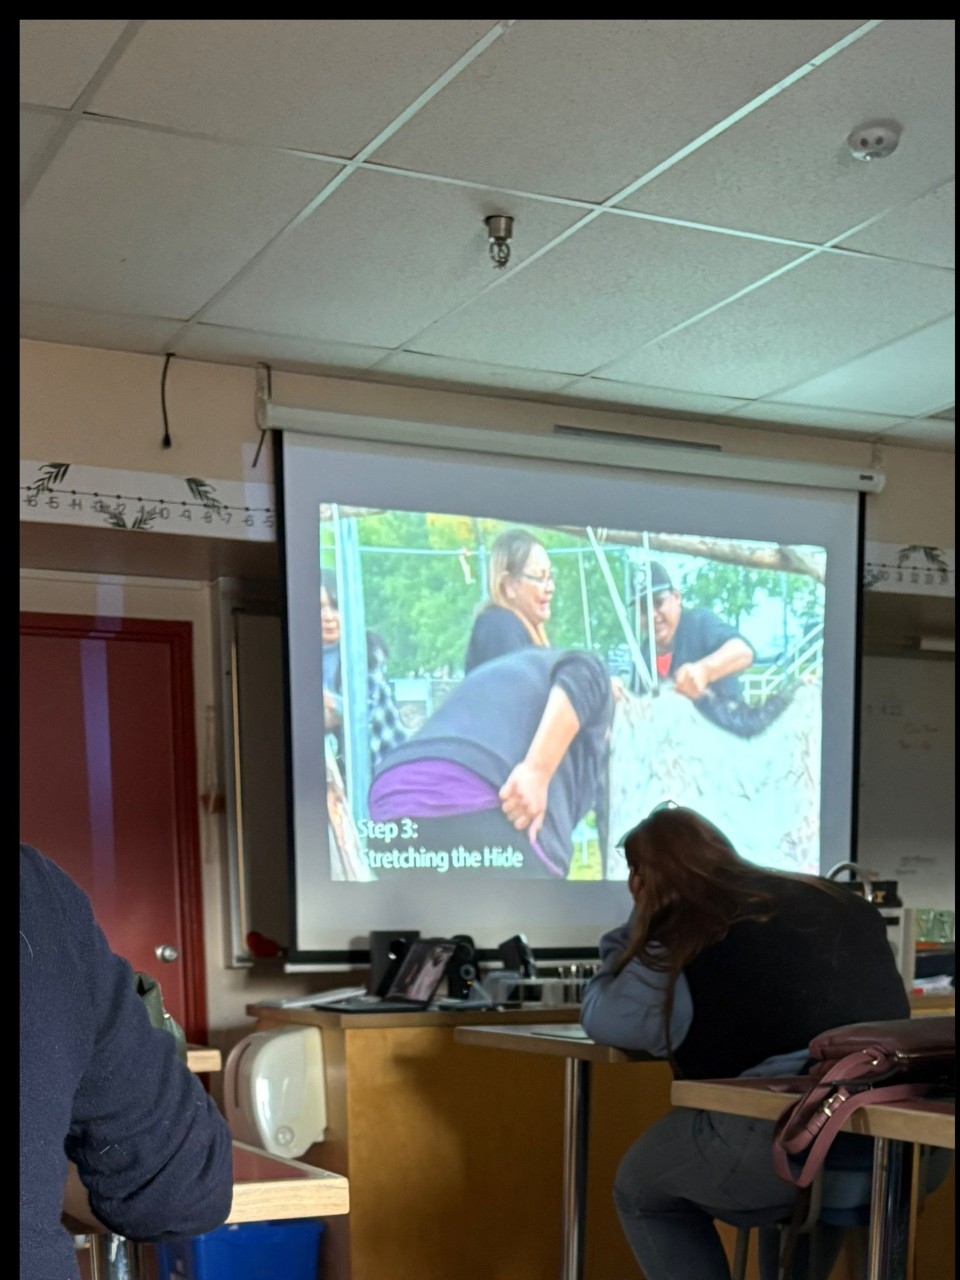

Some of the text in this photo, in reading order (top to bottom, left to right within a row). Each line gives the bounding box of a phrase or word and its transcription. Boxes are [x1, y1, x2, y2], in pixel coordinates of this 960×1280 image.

[357, 818, 418, 843] Step 3:
[361, 845, 524, 873] Stretching the Hide
